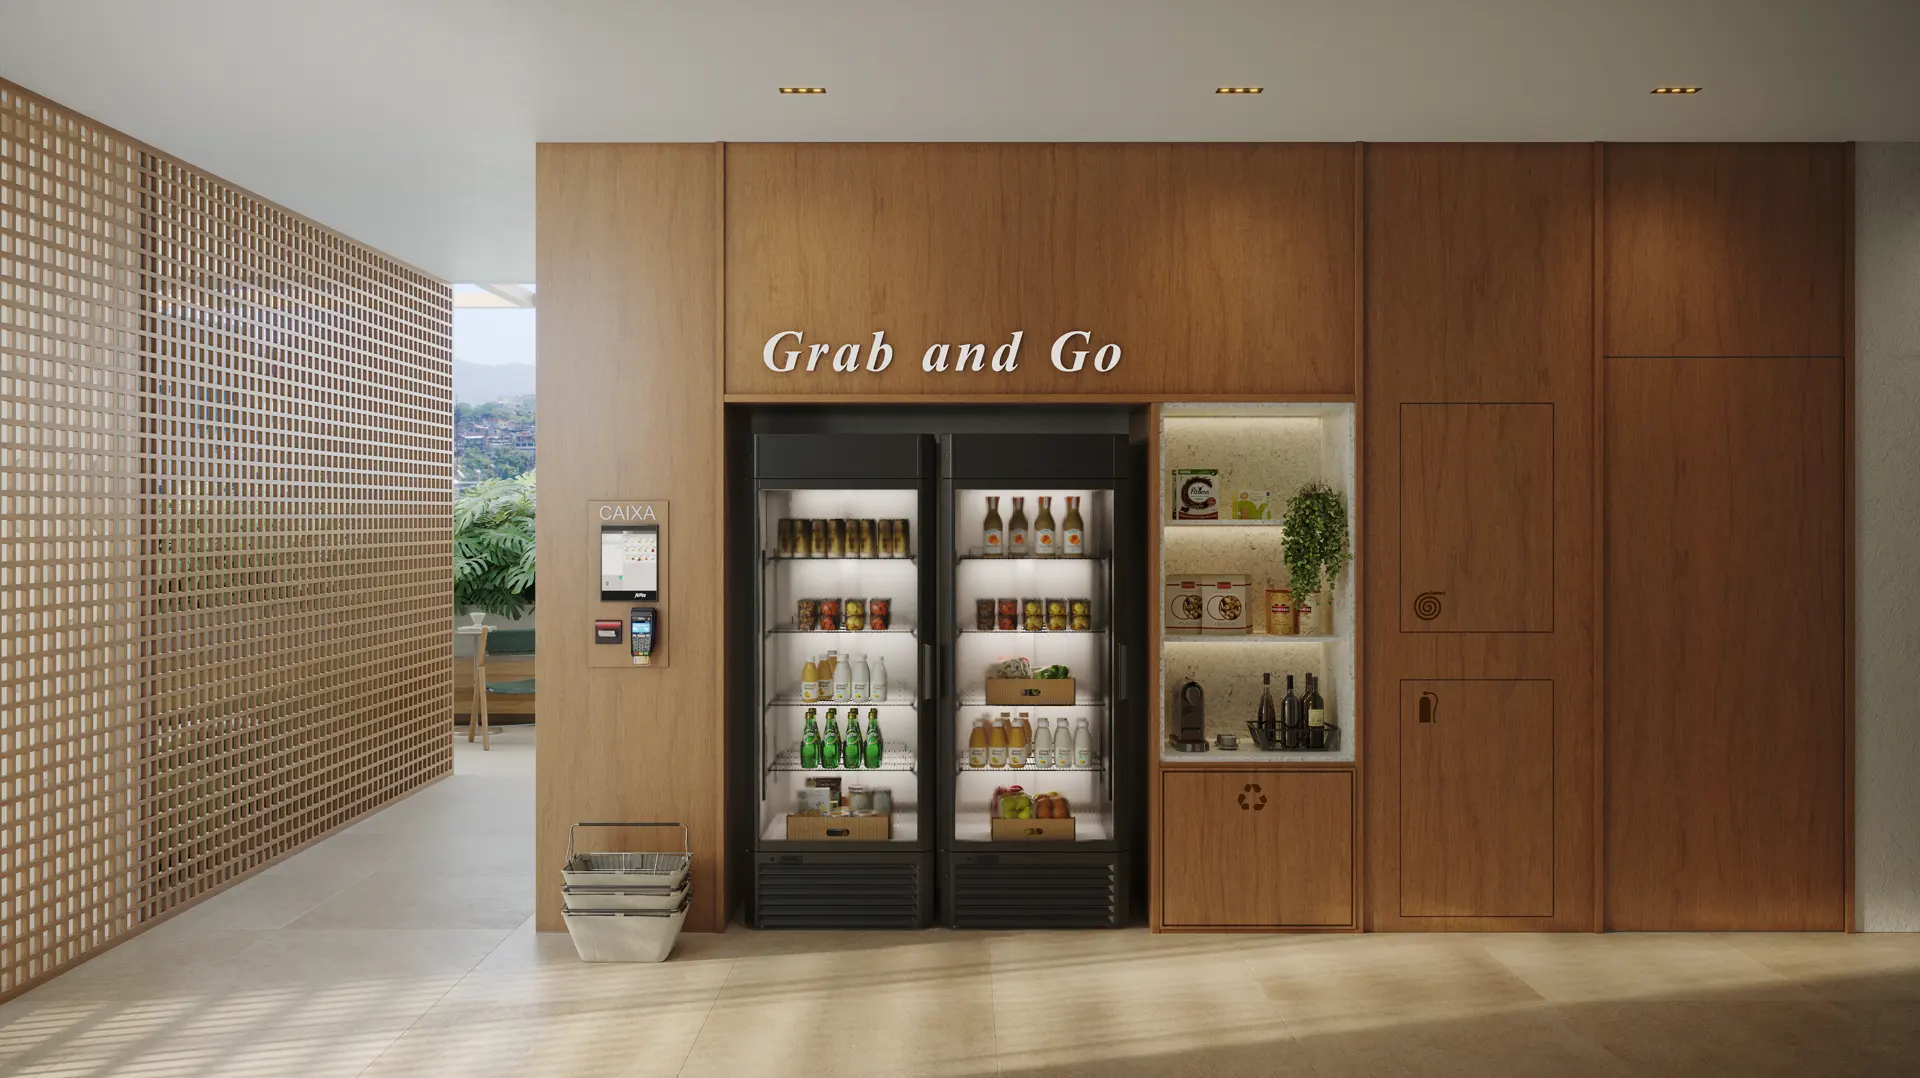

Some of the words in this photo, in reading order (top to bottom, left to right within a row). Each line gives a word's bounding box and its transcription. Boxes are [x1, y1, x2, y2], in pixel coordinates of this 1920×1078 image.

[762, 330, 894, 373] Grab
[921, 330, 1024, 373] and
[1049, 330, 1123, 373] Go
[599, 505, 656, 521] CAIXA
